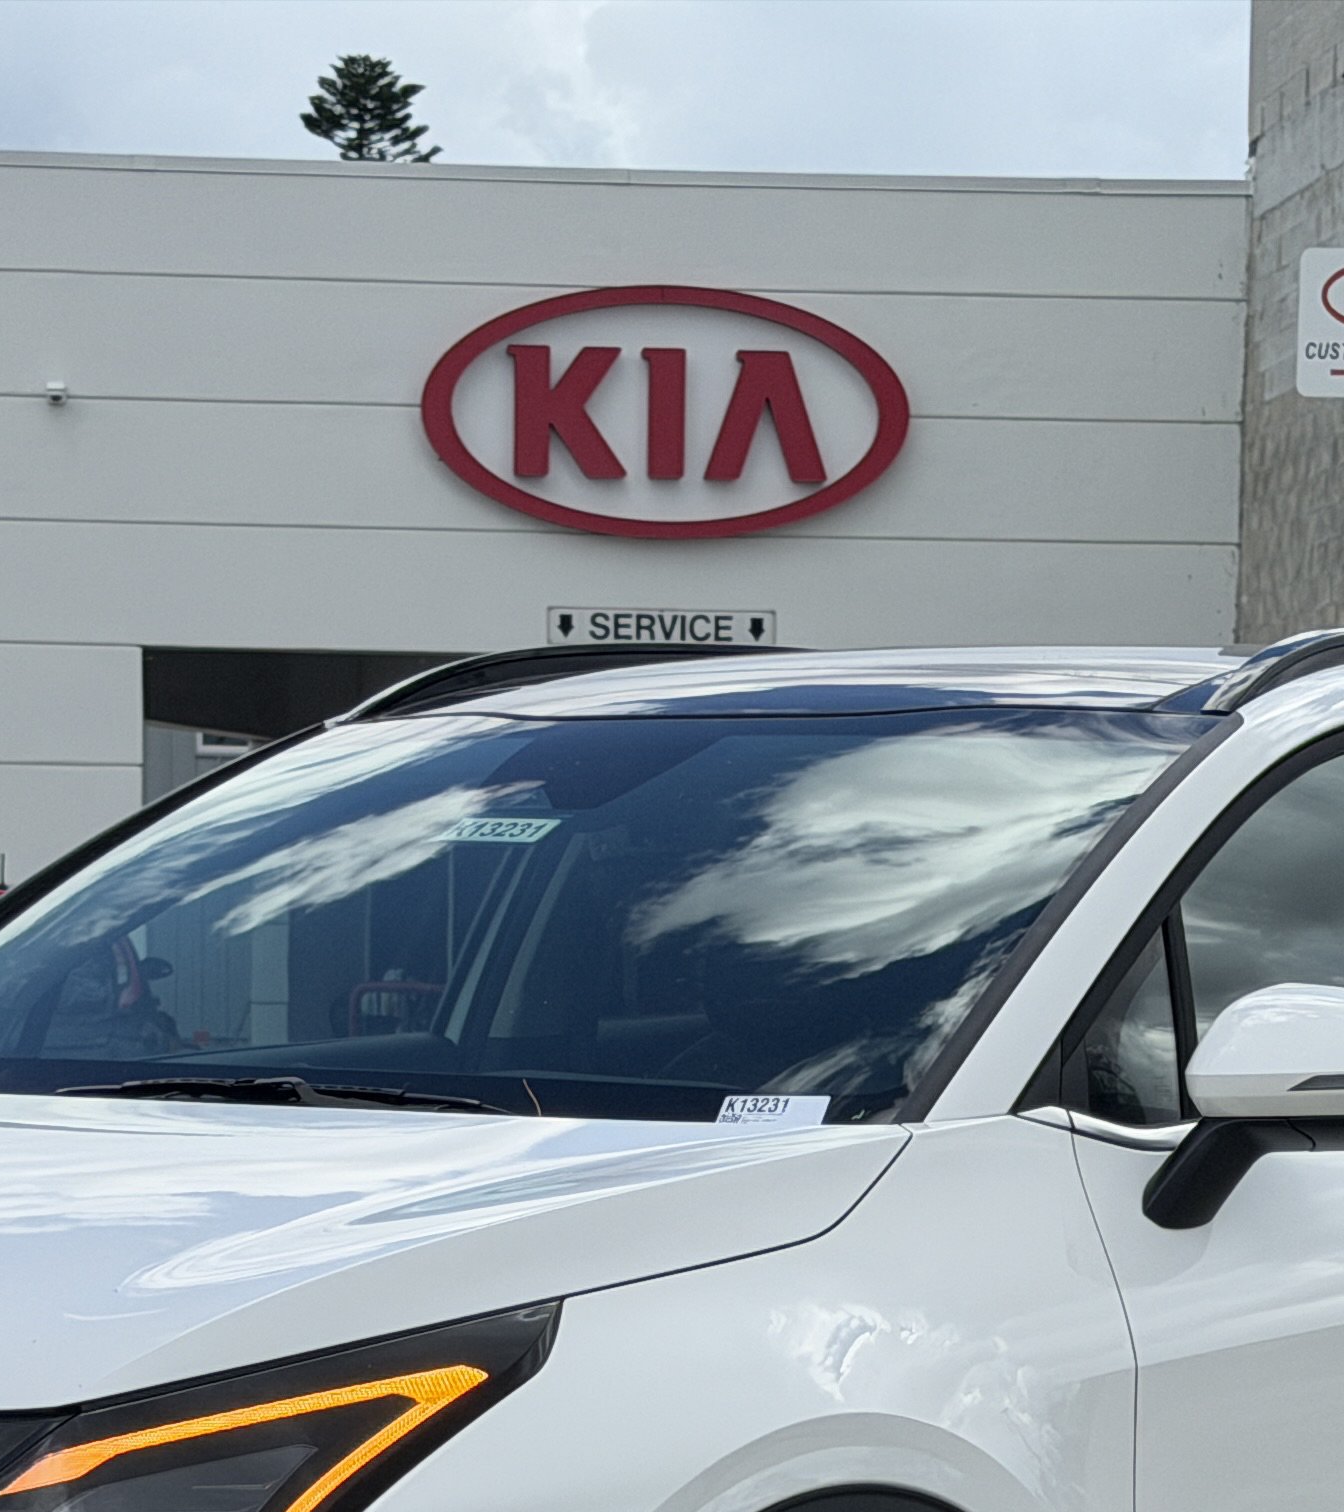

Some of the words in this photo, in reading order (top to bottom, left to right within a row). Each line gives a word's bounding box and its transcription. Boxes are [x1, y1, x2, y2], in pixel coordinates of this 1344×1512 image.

[506, 344, 827, 483] KIA
[588, 613, 733, 642] SERVICE
[724, 1097, 790, 1114] K13231
